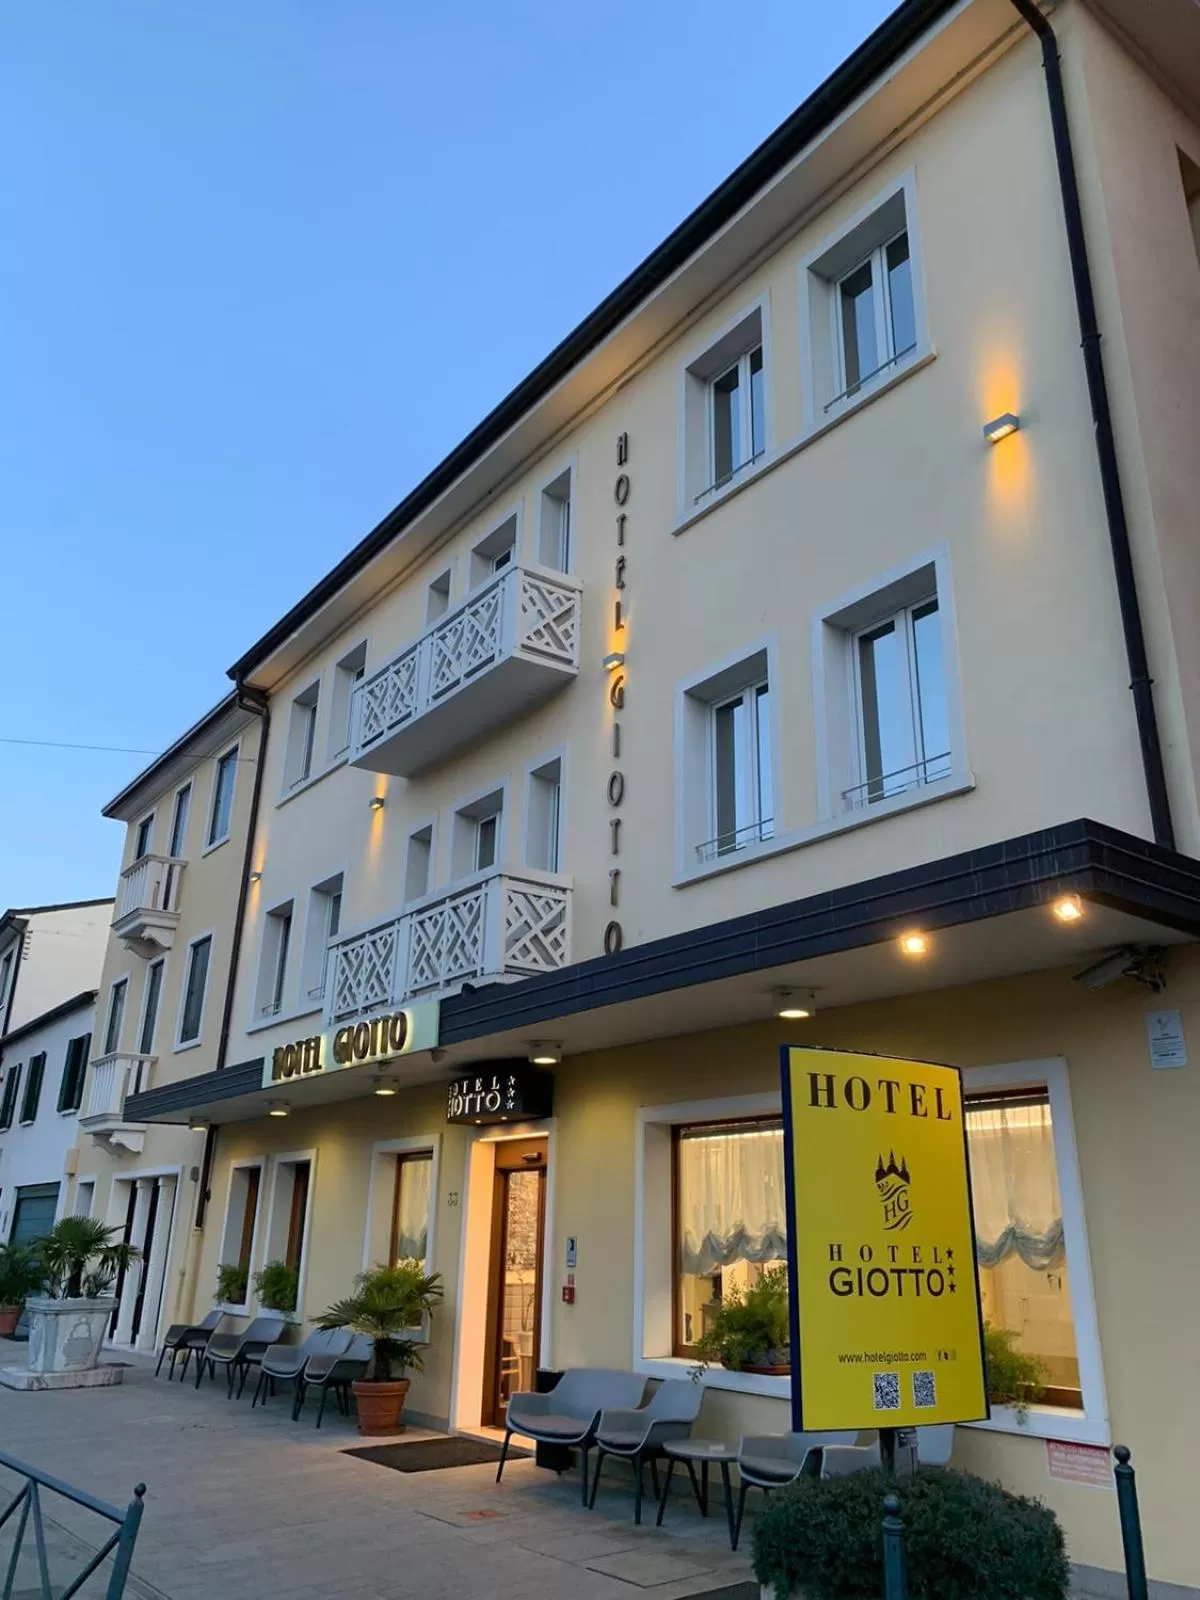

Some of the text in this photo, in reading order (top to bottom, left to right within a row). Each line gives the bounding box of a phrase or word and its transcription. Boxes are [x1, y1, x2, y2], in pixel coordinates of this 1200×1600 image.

[615, 432, 630, 632] HOTEL
[604, 675, 624, 956] GIOTTO
[271, 1011, 408, 1081] HOTEL GIOTTO
[448, 1075, 500, 1098] OTEL
[807, 1072, 952, 1121] HOTEL
[447, 1090, 501, 1119] IOTTO
[828, 1243, 943, 1263] HOTEL
[828, 1266, 945, 1297] GIOTTO
[838, 1351, 928, 1365] www.hotelgiotto.com
